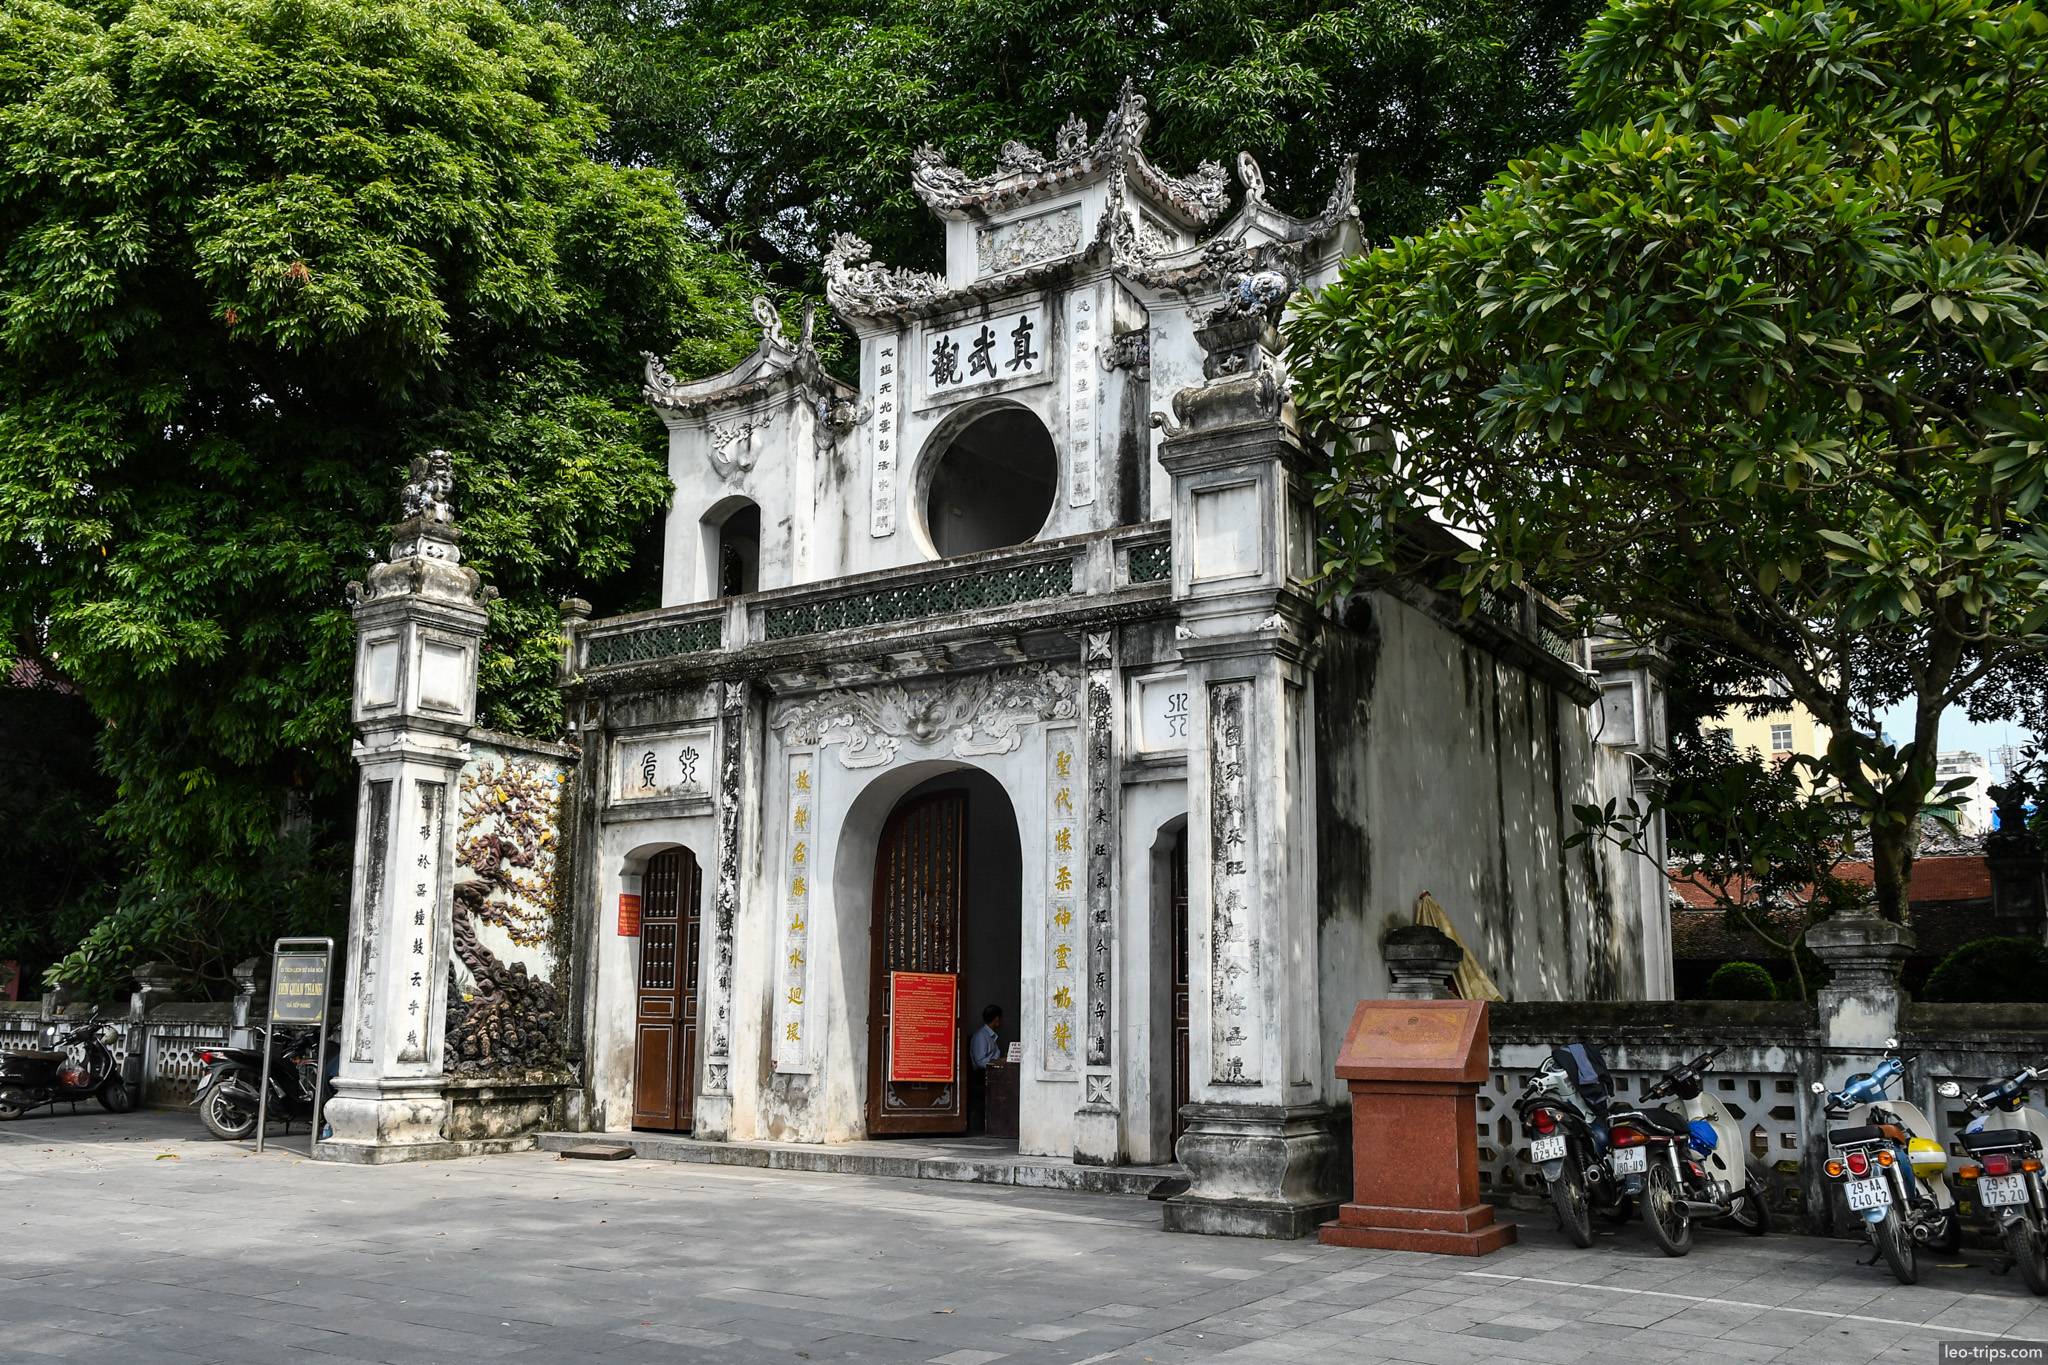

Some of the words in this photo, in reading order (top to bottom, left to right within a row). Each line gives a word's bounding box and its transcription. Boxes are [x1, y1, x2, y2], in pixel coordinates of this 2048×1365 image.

[929, 315, 1039, 388] 真武觀
[1535, 1137, 1560, 1151] 29-F1
[1624, 1149, 1634, 1160] 29
[1851, 1178, 1882, 1195] 29-AA
[1985, 1176, 2018, 1191] 29-Y3
[1851, 1190, 1889, 1208] 240.42
[1984, 1189, 2025, 1205] 175.20
